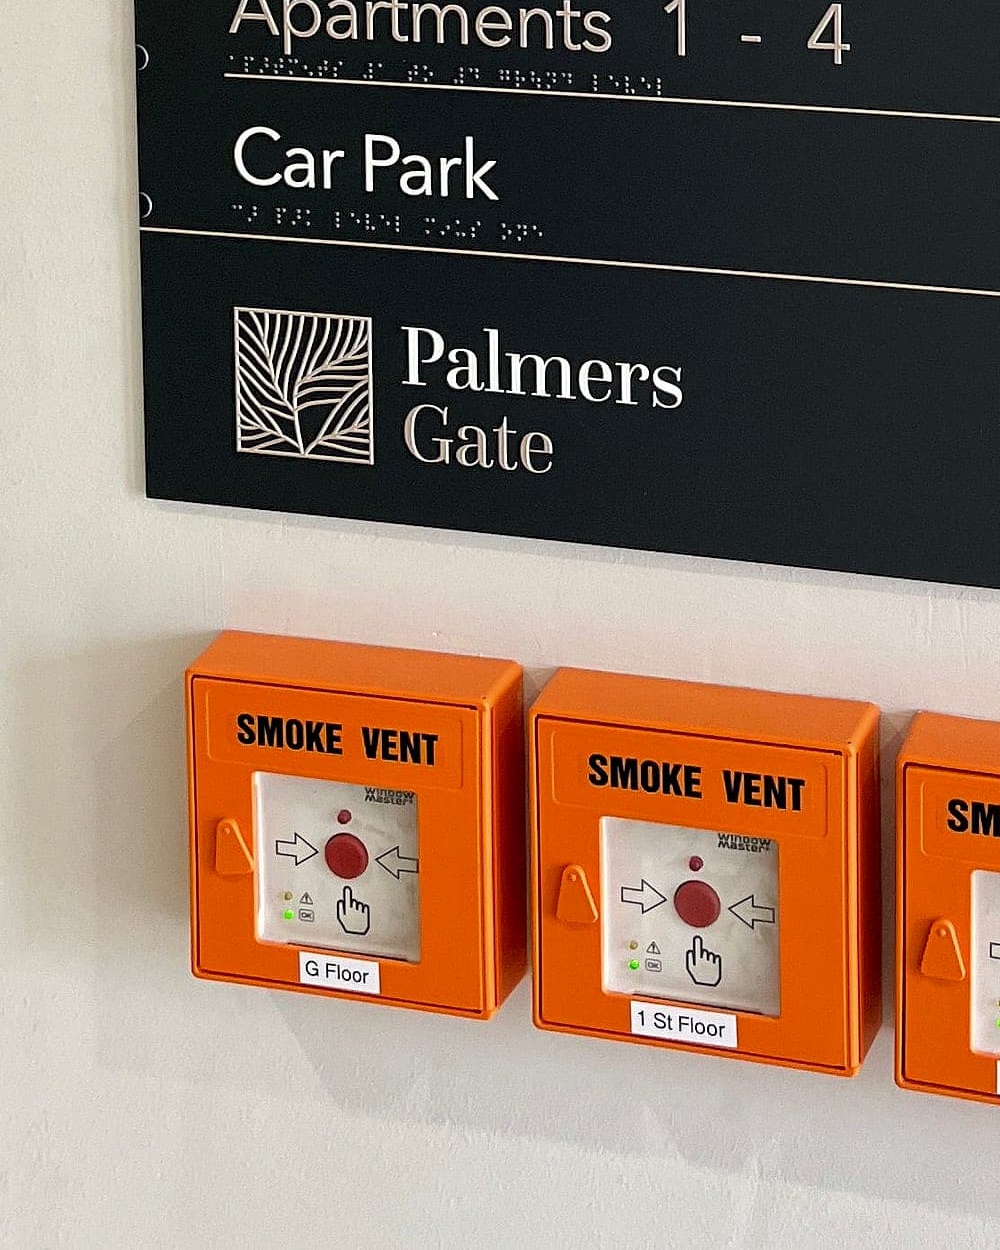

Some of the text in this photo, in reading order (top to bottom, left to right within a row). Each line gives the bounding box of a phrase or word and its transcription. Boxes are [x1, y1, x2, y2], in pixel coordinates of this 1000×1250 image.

[740, 34, 762, 43] -
[807, 3, 851, 65] 4
[233, 126, 345, 192] Car
[364, 133, 500, 202] Park
[400, 326, 683, 409] Palmers
[404, 403, 554, 475] Gate
[237, 713, 438, 766] SMOKE VENT
[588, 754, 805, 811] SMOKE VENT
[305, 960, 369, 985] G Floor
[637, 1010, 726, 1038] 1 St Floor
